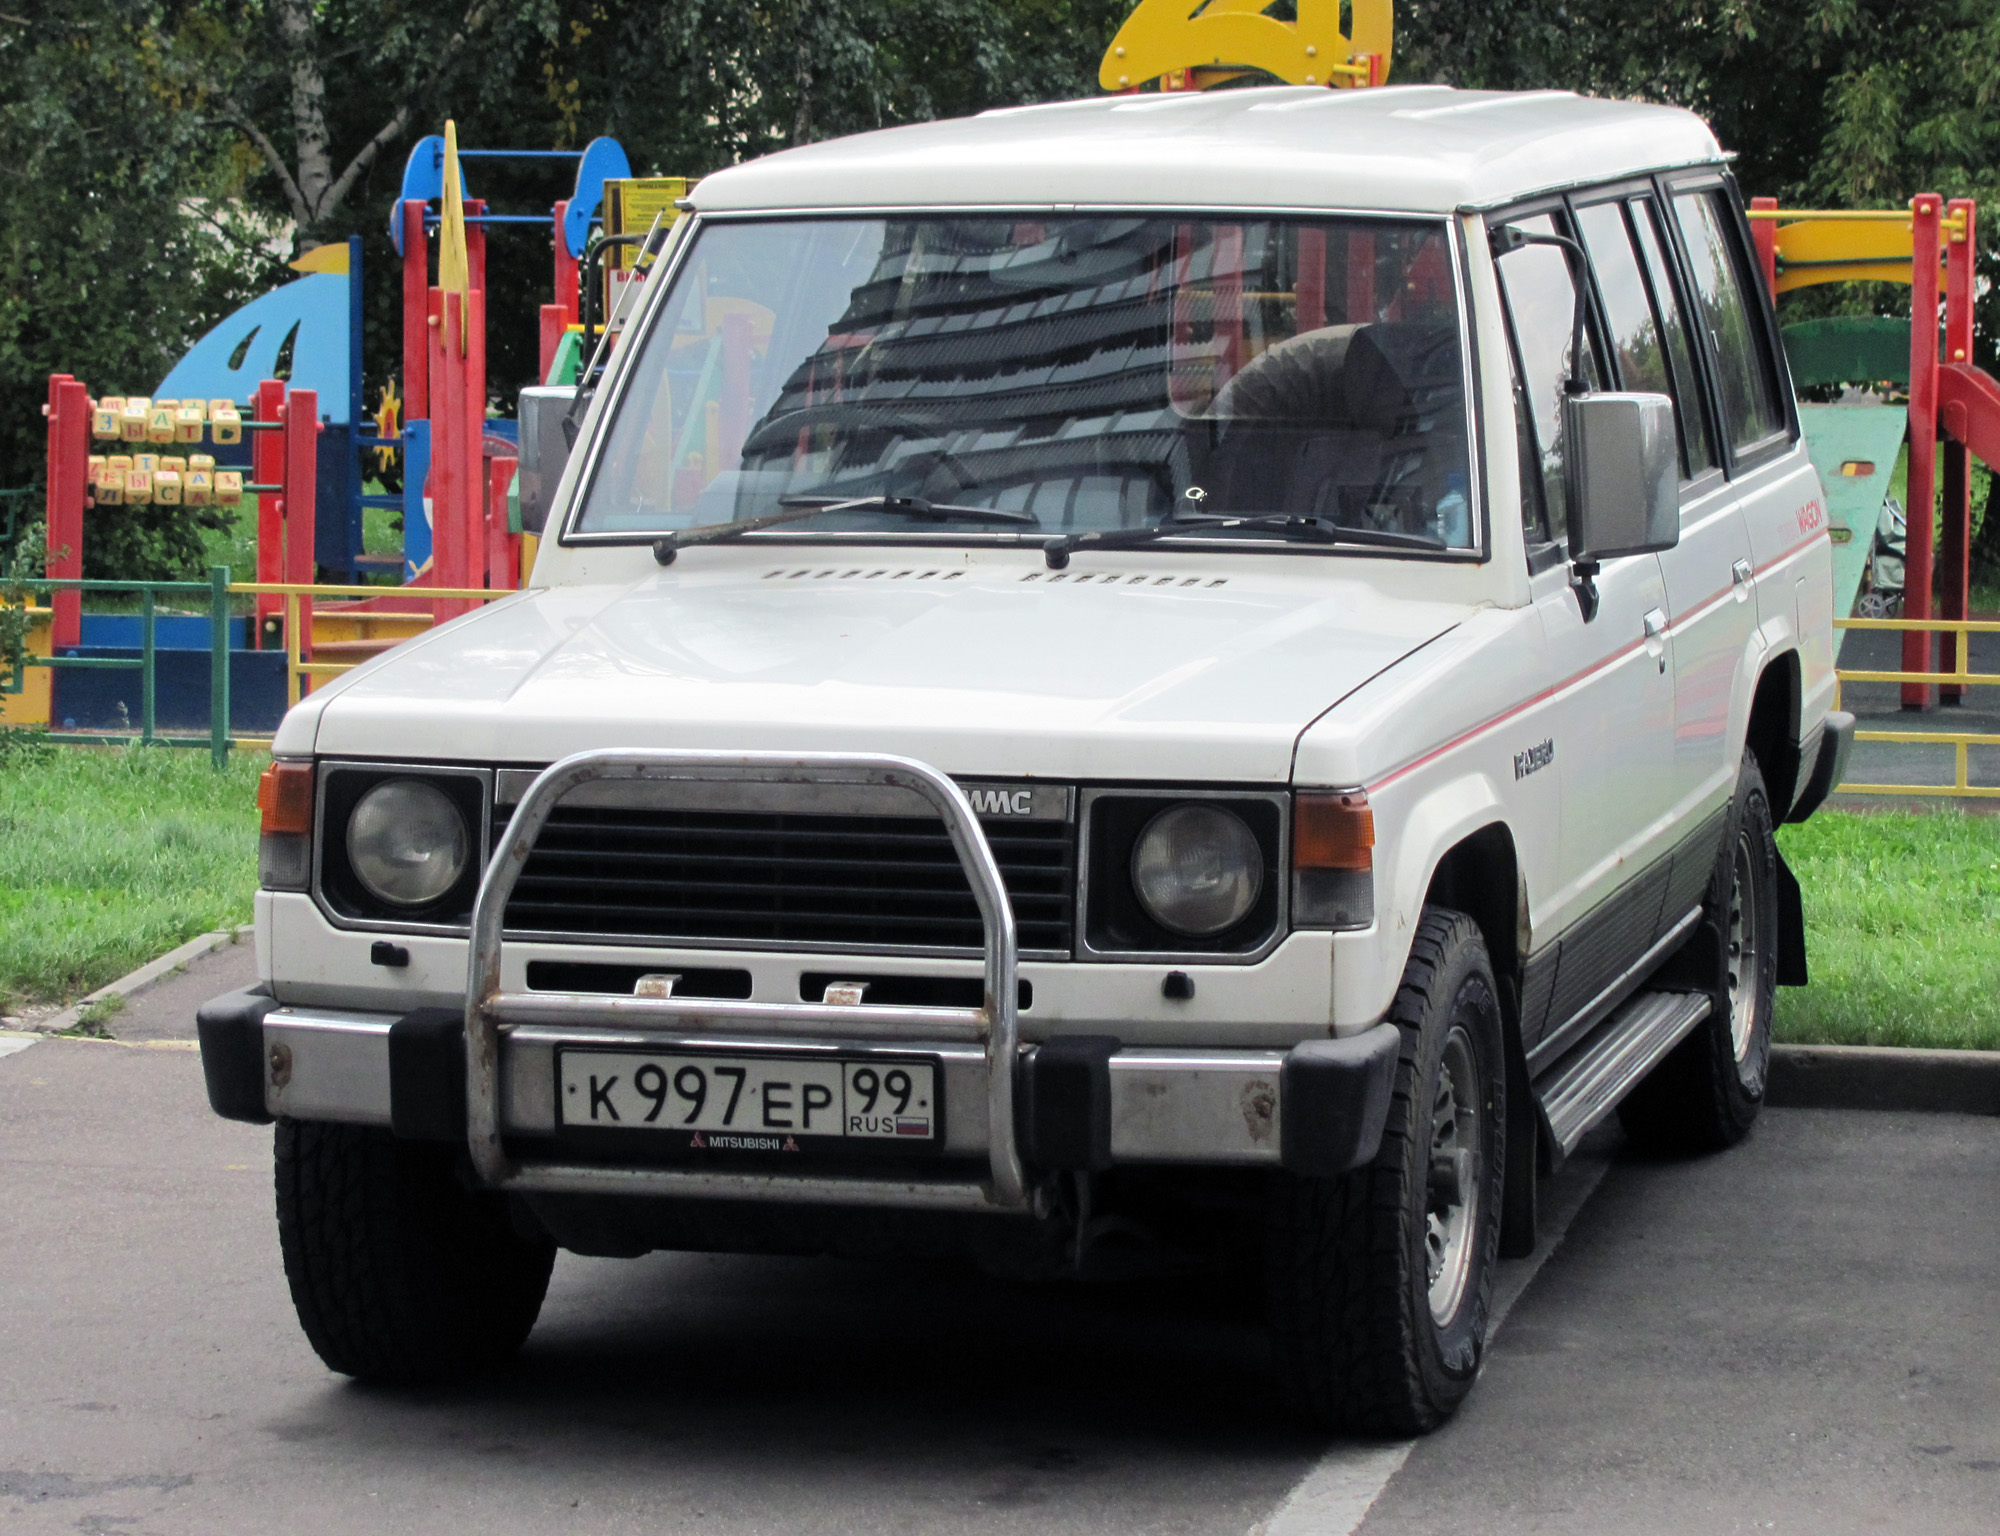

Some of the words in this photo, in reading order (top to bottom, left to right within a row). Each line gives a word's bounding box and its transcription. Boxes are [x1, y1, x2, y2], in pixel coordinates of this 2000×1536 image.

[851, 1067, 913, 1115] 99
[849, 1116, 894, 1134] RUS
[708, 1135, 780, 1151] MITSUBISHI
